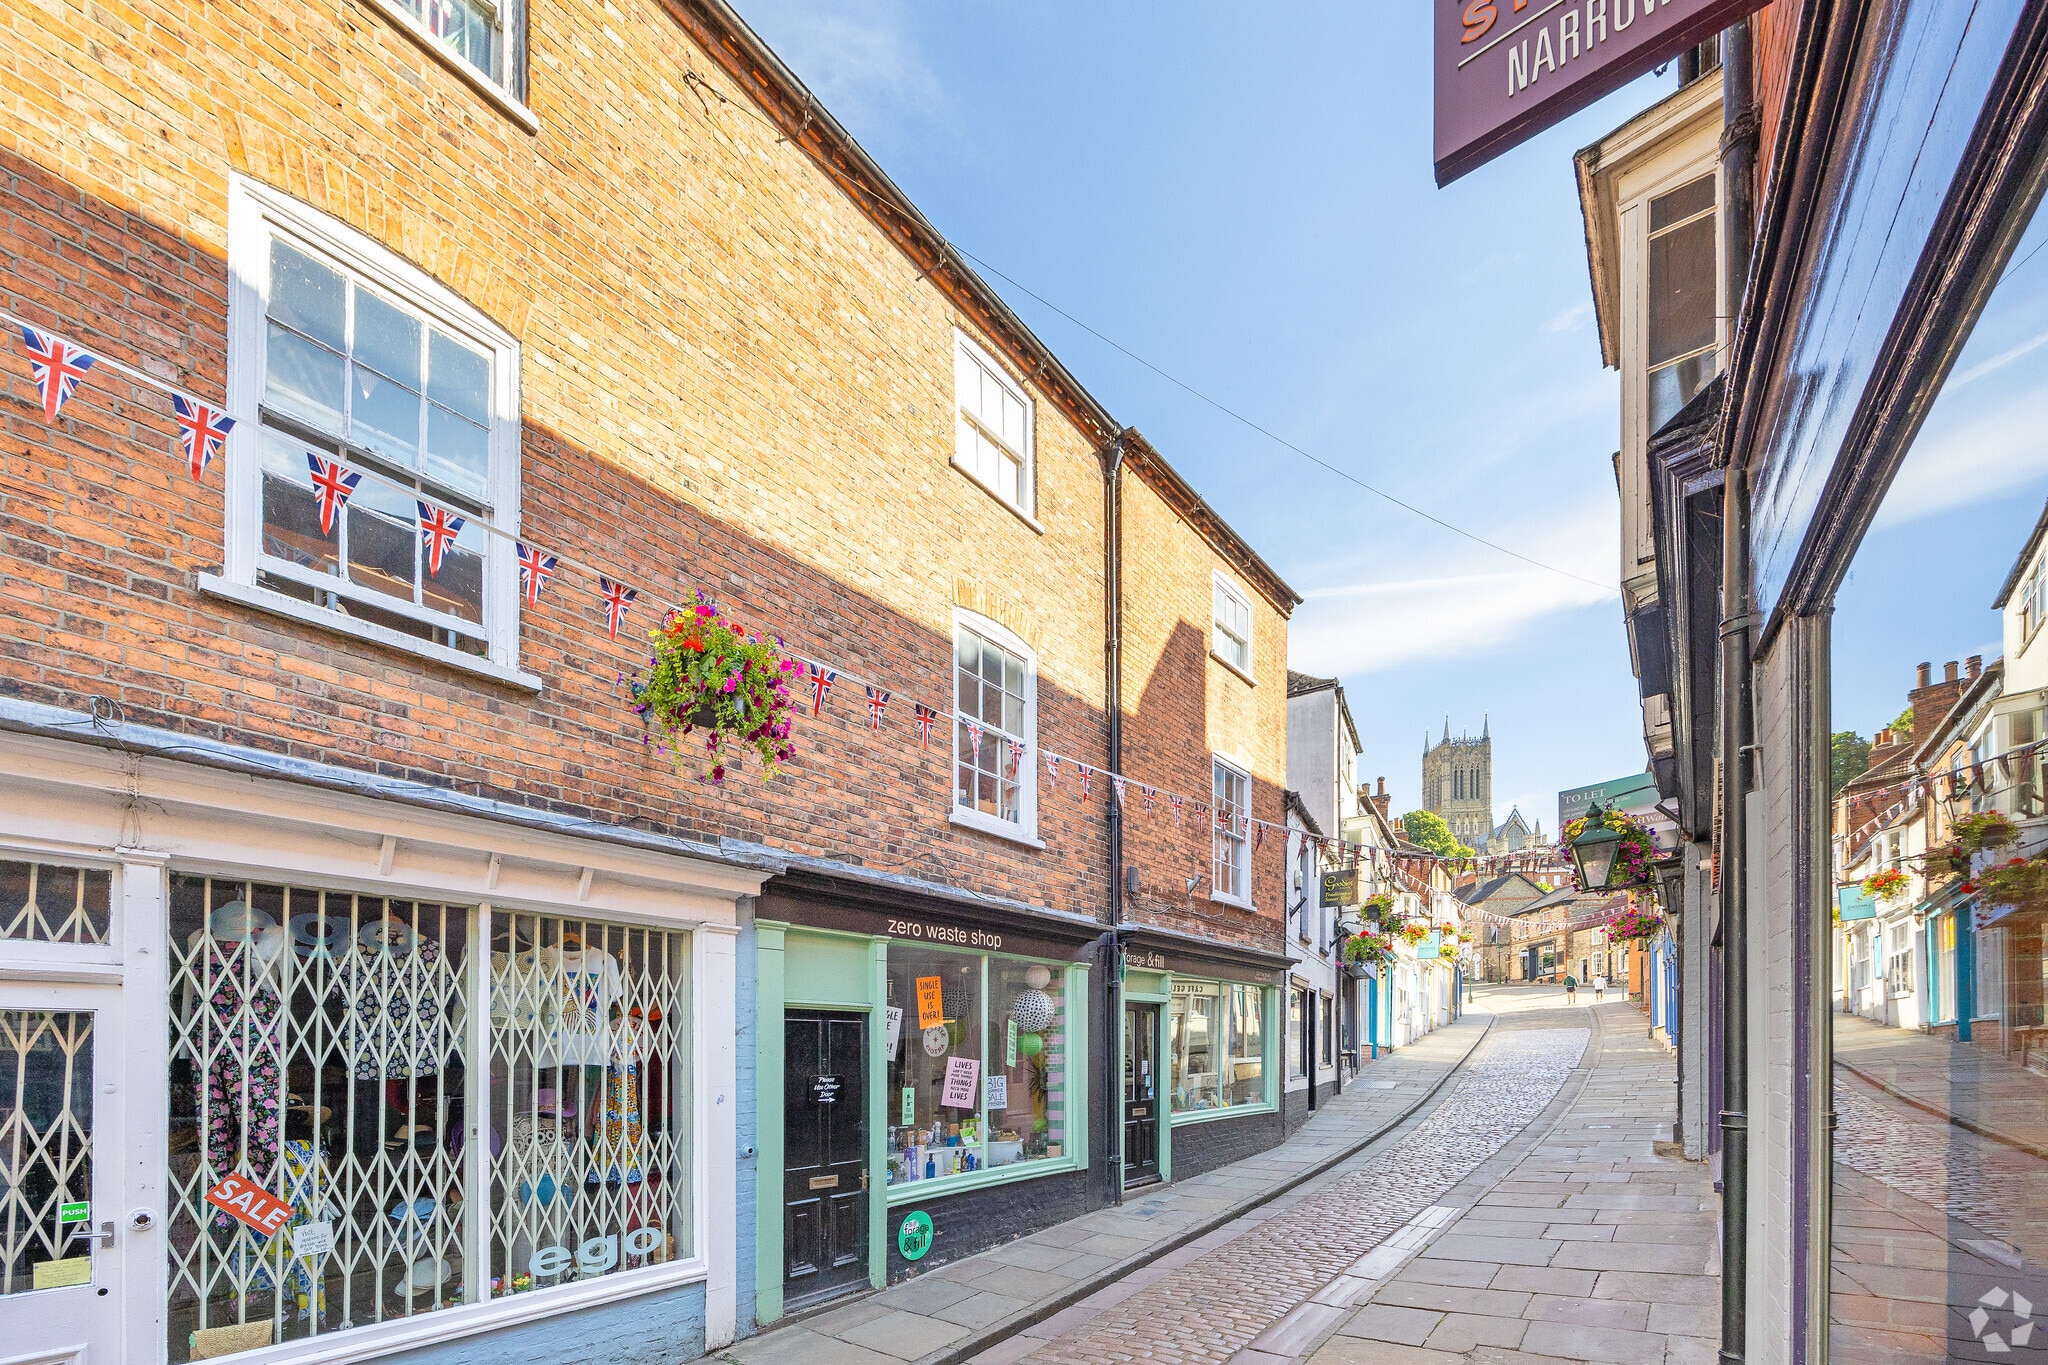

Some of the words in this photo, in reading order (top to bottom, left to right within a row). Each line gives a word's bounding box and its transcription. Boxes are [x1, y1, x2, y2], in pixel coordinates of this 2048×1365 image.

[1461, 0, 1527, 44] S
[1563, 794, 1581, 804] TO
[1583, 788, 1606, 801] LET
[888, 920, 922, 937] zero
[926, 925, 967, 943] waste
[971, 929, 1002, 950] shop
[1124, 947, 1145, 967] forage
[920, 980, 939, 991] SINGLE
[923, 991, 935, 1000] USE
[927, 1001, 934, 1010] IS
[922, 1010, 940, 1020] OVER!
[954, 1061, 973, 1070] LIVES
[950, 1078, 972, 1088] THINGS
[987, 1077, 1004, 1089] BIG
[949, 1092, 968, 1101] LIVES
[213, 1179, 289, 1230] SALE
[62, 1208, 87, 1217] PUSH
[904, 1223, 930, 1236] forage
[528, 1226, 662, 1277] ego
